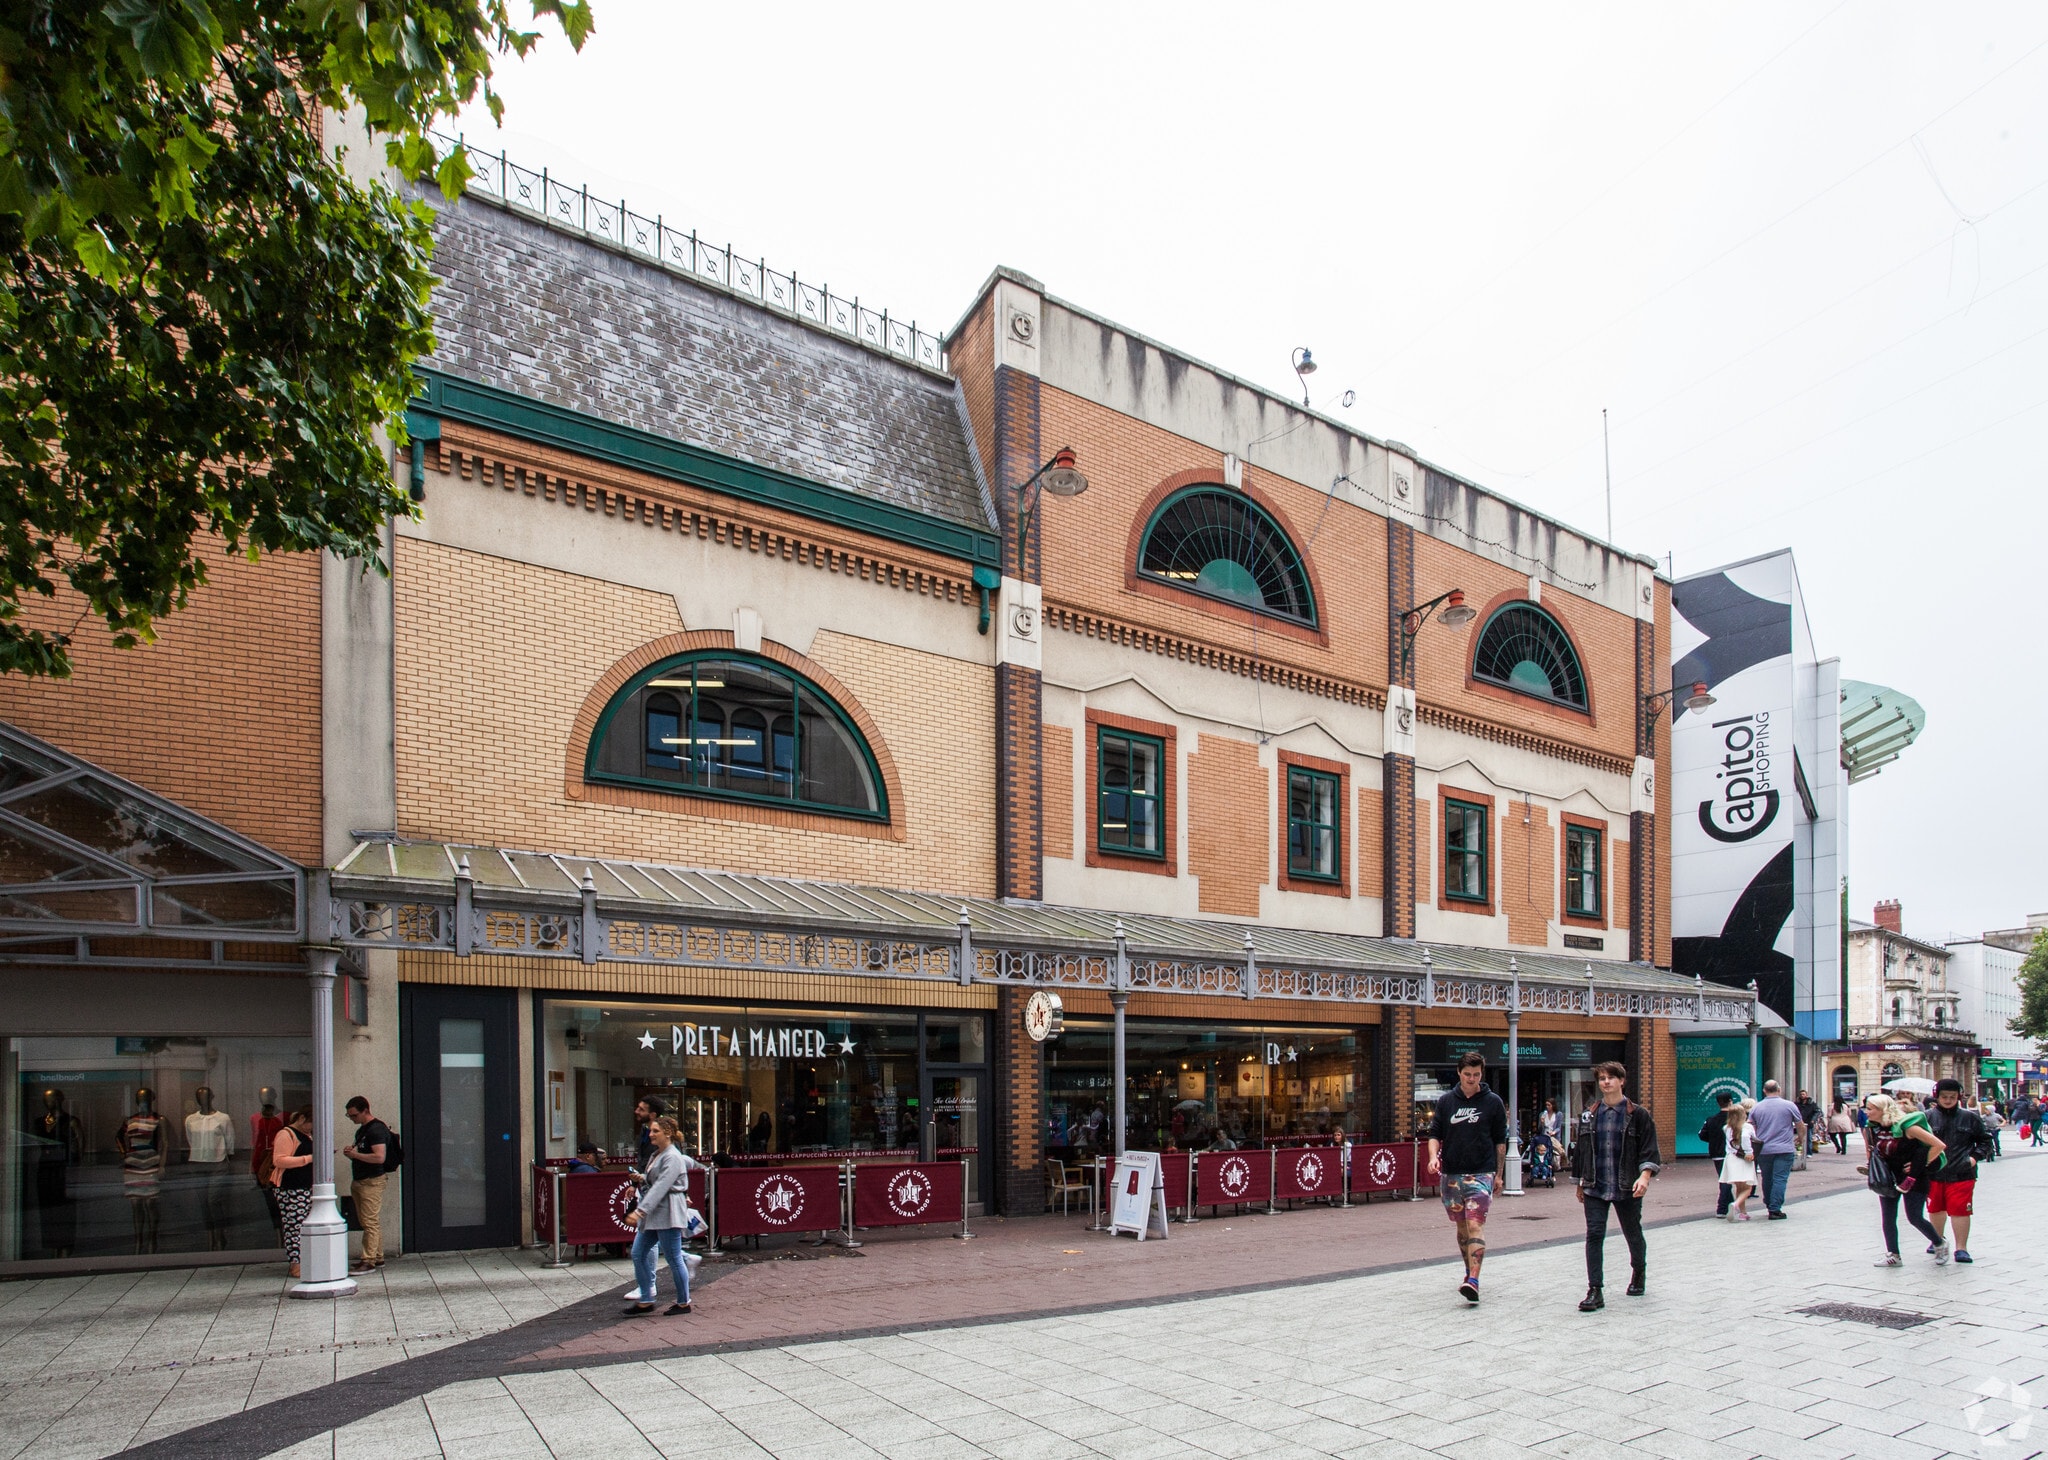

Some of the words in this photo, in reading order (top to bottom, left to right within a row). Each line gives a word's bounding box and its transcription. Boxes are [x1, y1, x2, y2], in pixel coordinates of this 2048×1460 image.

[1755, 711, 1770, 791] SHOPPING
[1698, 715, 1780, 843] Capitol
[671, 1025, 721, 1056] PRET
[729, 1028, 741, 1056] A
[750, 1027, 827, 1058] MANGER
[1515, 1043, 1542, 1055] anesha
[1455, 1107, 1477, 1117] NIKE
[1468, 1115, 1480, 1123] SB
[755, 1174, 781, 1199] ORGANIC
[783, 1174, 805, 1197] COFFEE
[888, 1169, 910, 1193] ORGANIC
[912, 1170, 931, 1191] COFFEE
[768, 1190, 792, 1209] PRET
[899, 1184, 920, 1202] PRET
[757, 1207, 787, 1226] NATURAL
[788, 1205, 804, 1223] FOOD
[889, 1200, 916, 1217] NATURAL
[916, 1198, 930, 1215] FOOD
